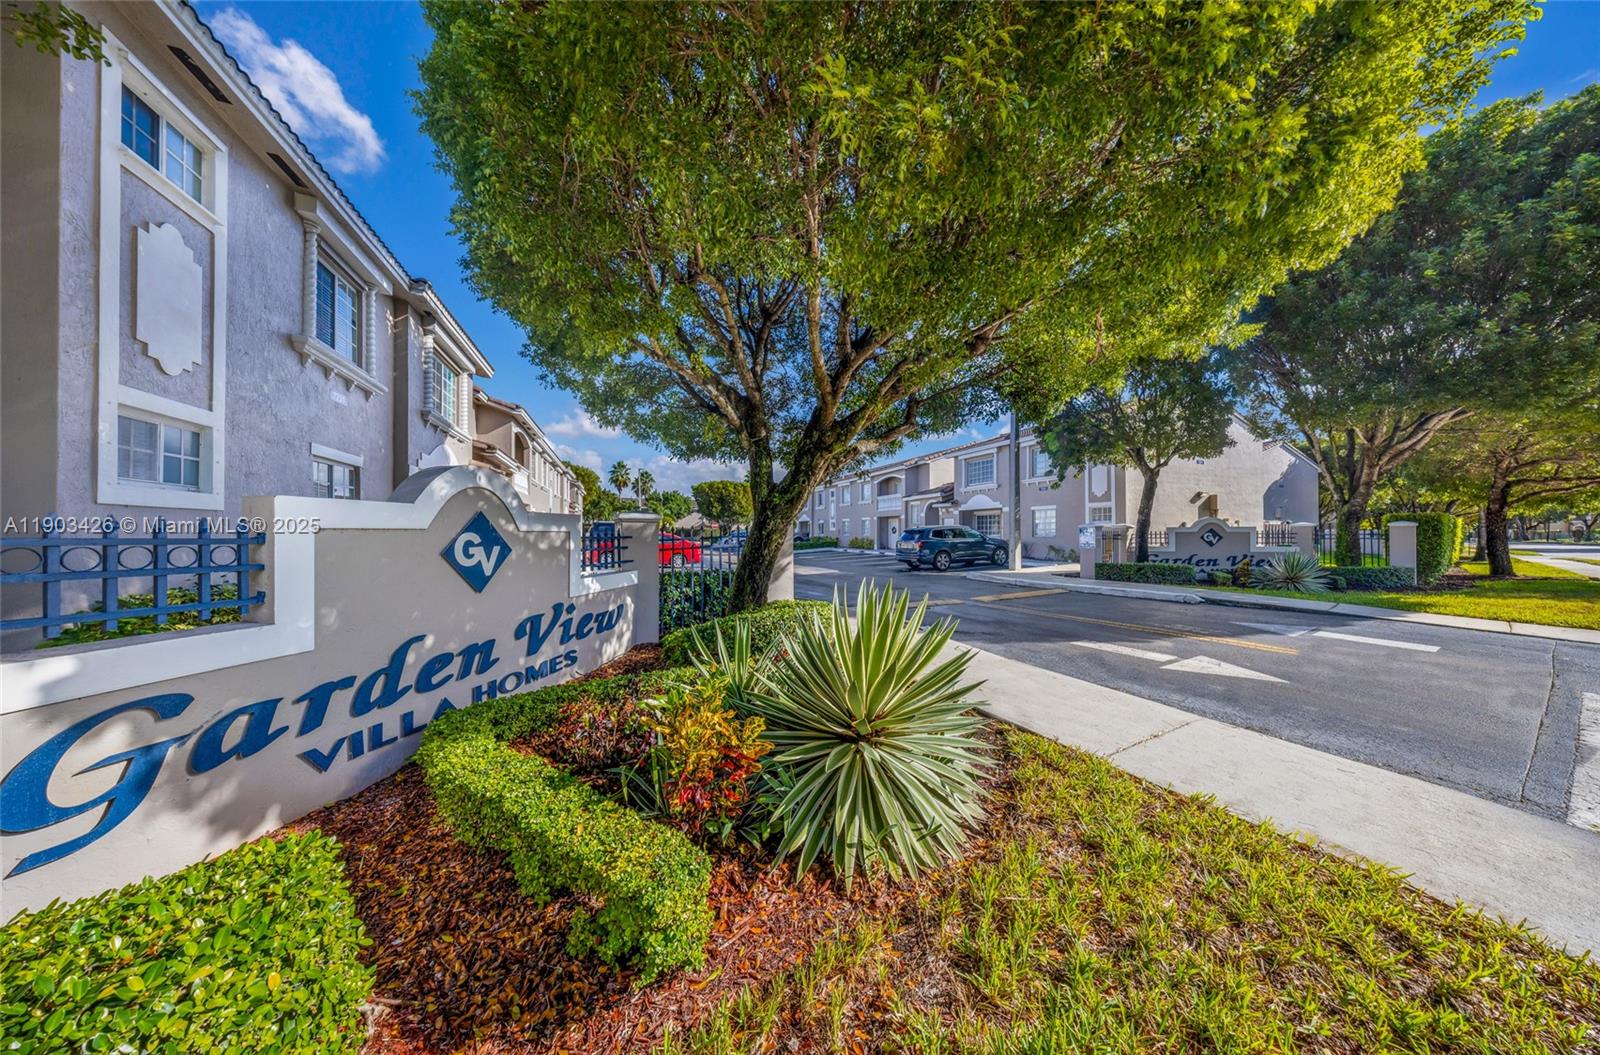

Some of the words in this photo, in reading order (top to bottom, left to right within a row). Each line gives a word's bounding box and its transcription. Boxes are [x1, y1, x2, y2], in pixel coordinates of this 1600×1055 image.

[454, 531, 501, 577] GV
[1203, 533, 1219, 544] GV
[472, 649, 578, 704] HOMES
[0, 634, 500, 881] Garden
[514, 602, 624, 658] View
